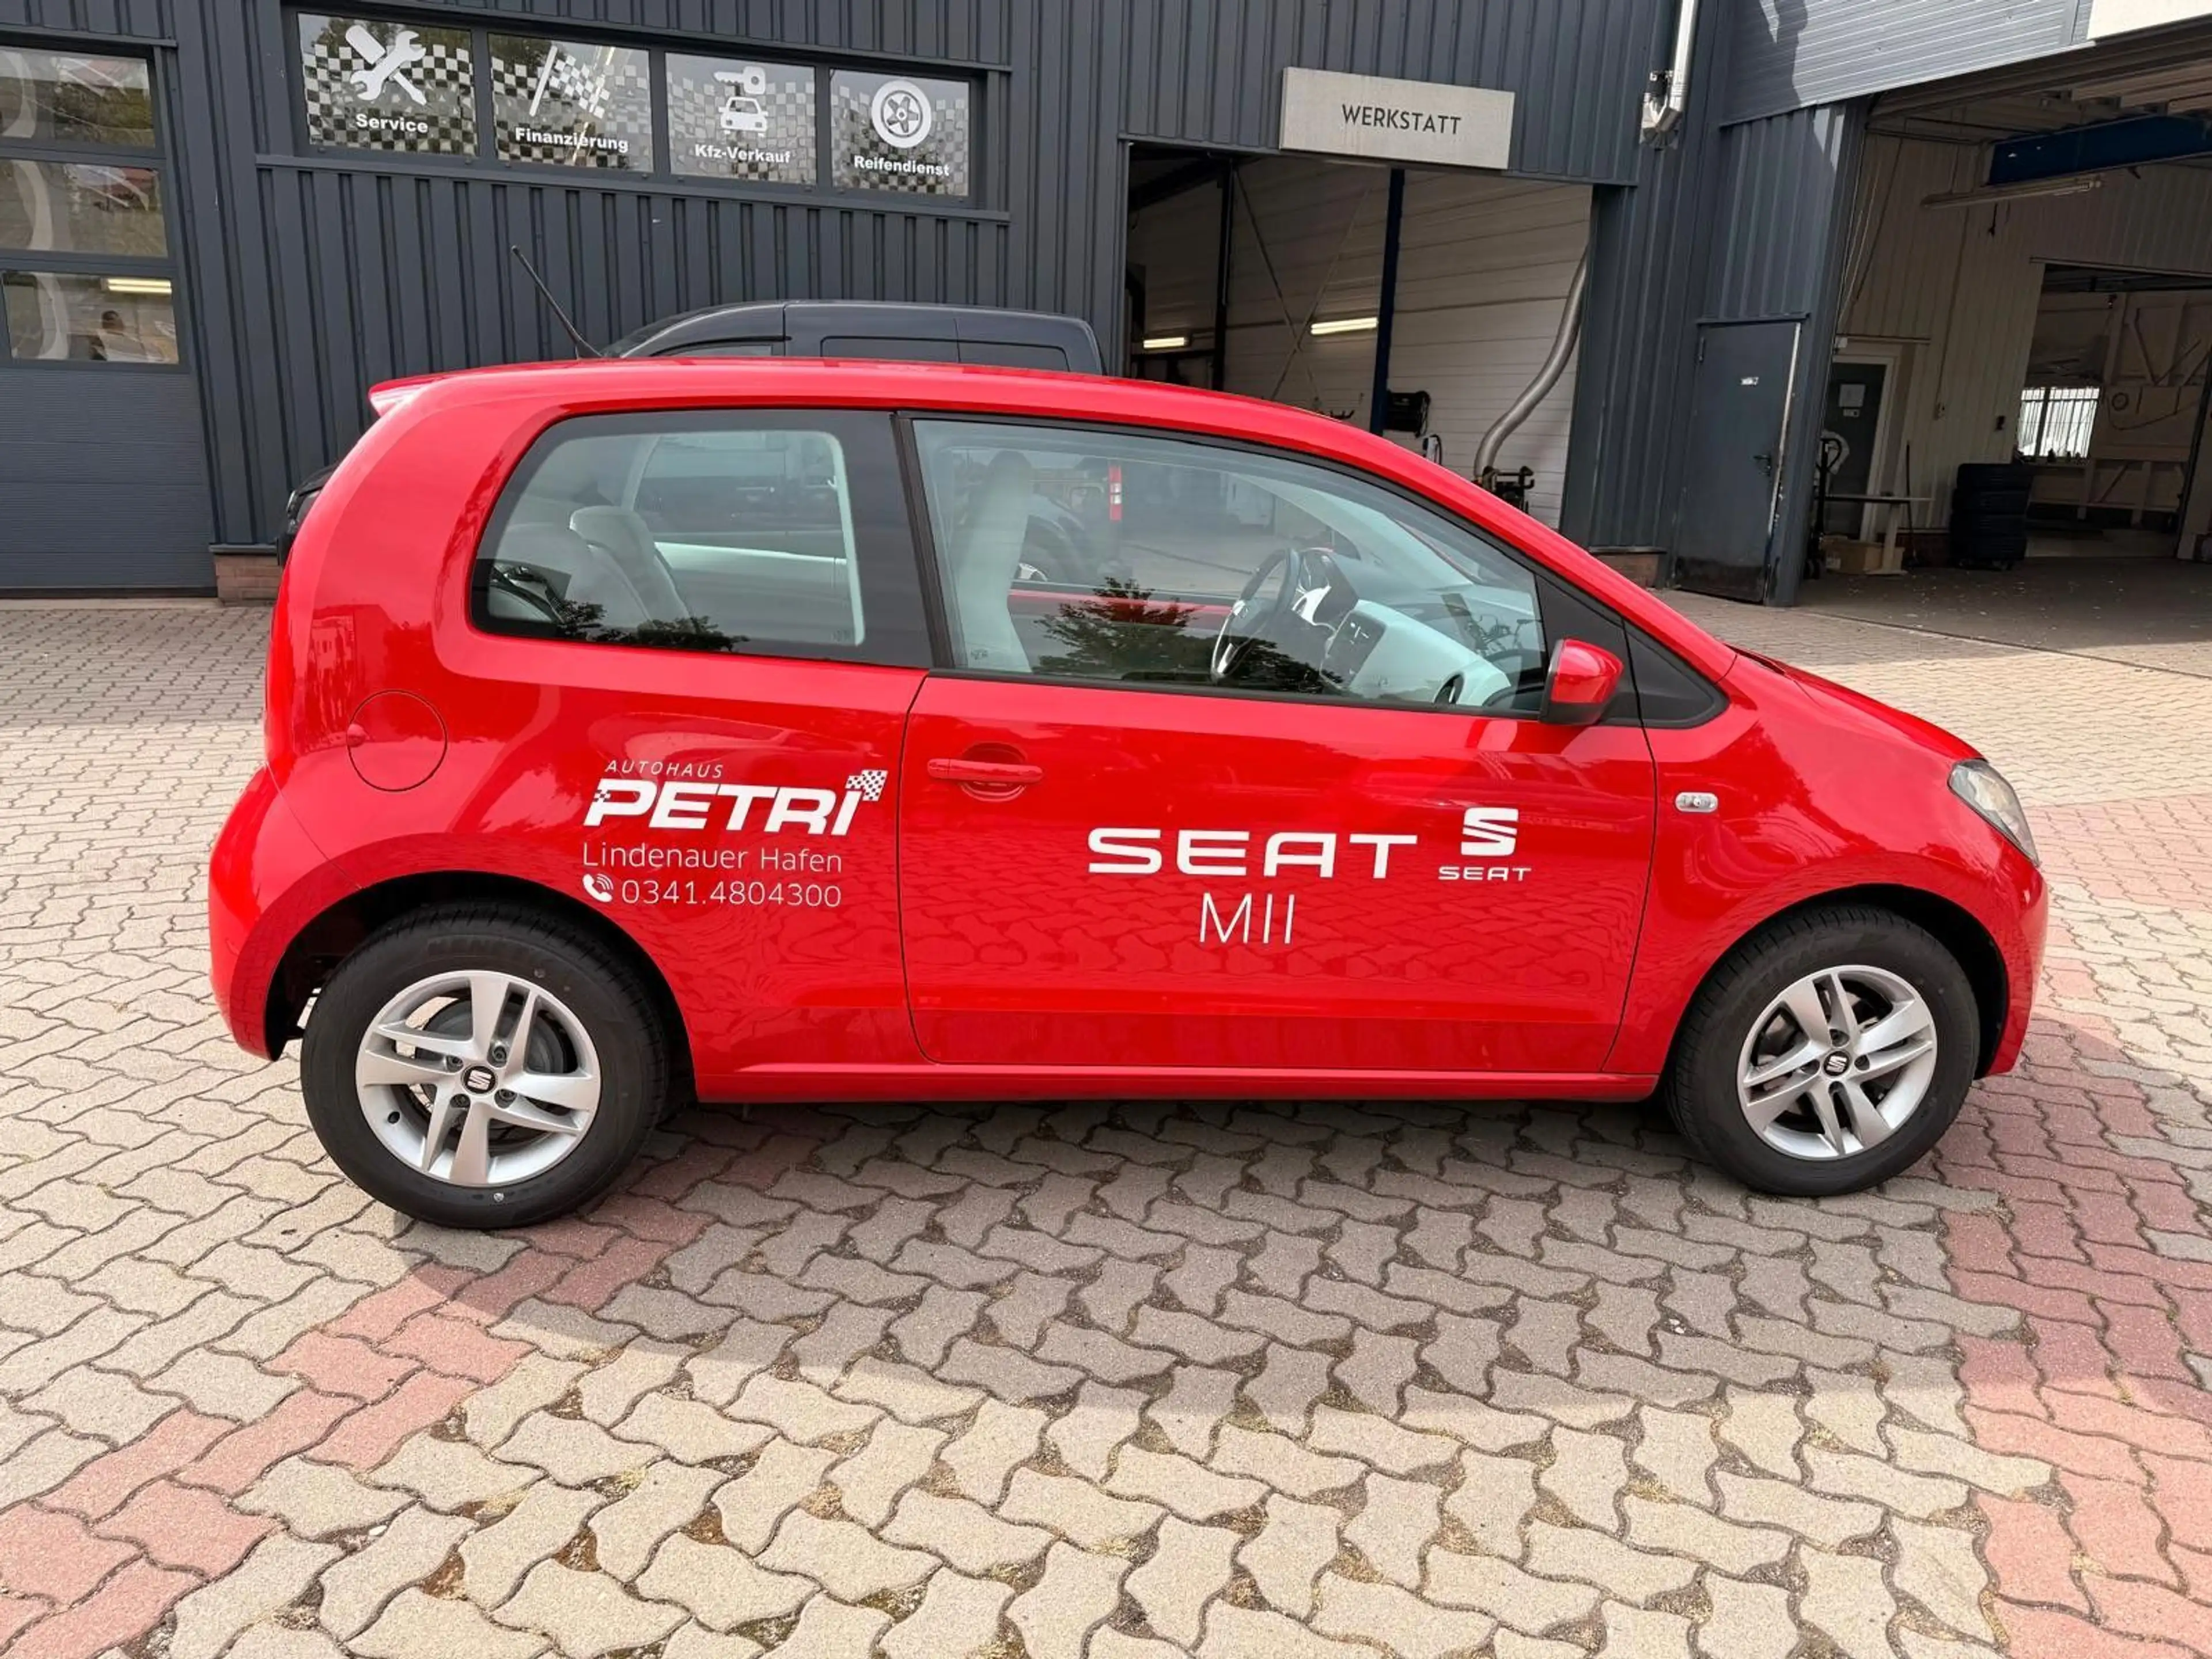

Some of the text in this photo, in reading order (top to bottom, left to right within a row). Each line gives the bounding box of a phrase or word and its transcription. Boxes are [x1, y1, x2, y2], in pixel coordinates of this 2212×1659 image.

[355, 112, 429, 134] Service
[1342, 104, 1461, 135] WERKSTATT
[515, 127, 630, 153] Finanzierung
[694, 143, 791, 164] Kfz-Verkauf
[854, 154, 950, 177] Reifendienst
[604, 759, 724, 778] AUTOHAUS
[584, 770, 888, 836] PETRI
[583, 842, 842, 873] Lindenauer Hafen
[1088, 827, 1418, 879] SEAT
[1438, 866, 1532, 881] SEAT
[622, 880, 841, 907] 0341.4804300
[1199, 892, 1295, 944] MII
